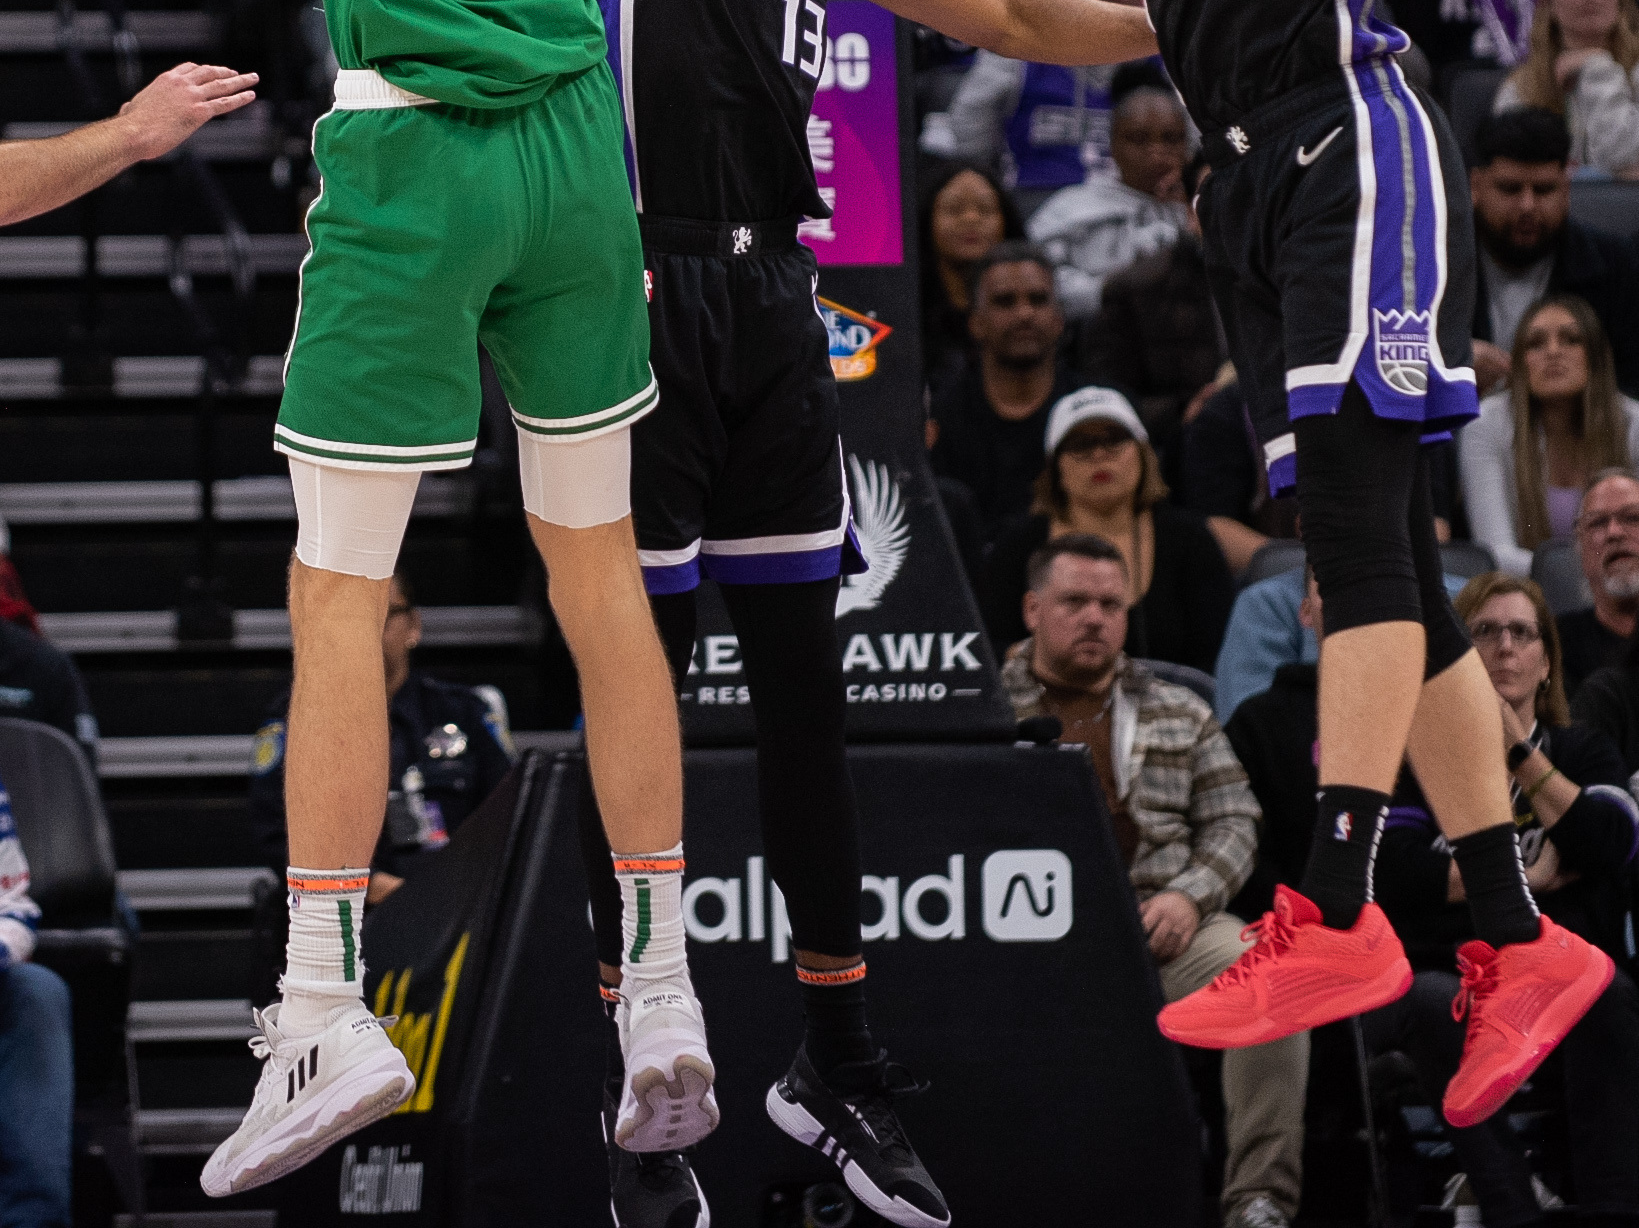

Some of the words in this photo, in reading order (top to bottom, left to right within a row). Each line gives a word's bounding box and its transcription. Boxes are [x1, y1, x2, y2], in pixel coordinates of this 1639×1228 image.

[1380, 344, 1430, 361] KING
[842, 632, 982, 671] AWK
[698, 686, 750, 705] RES
[846, 683, 947, 703] CASINO
